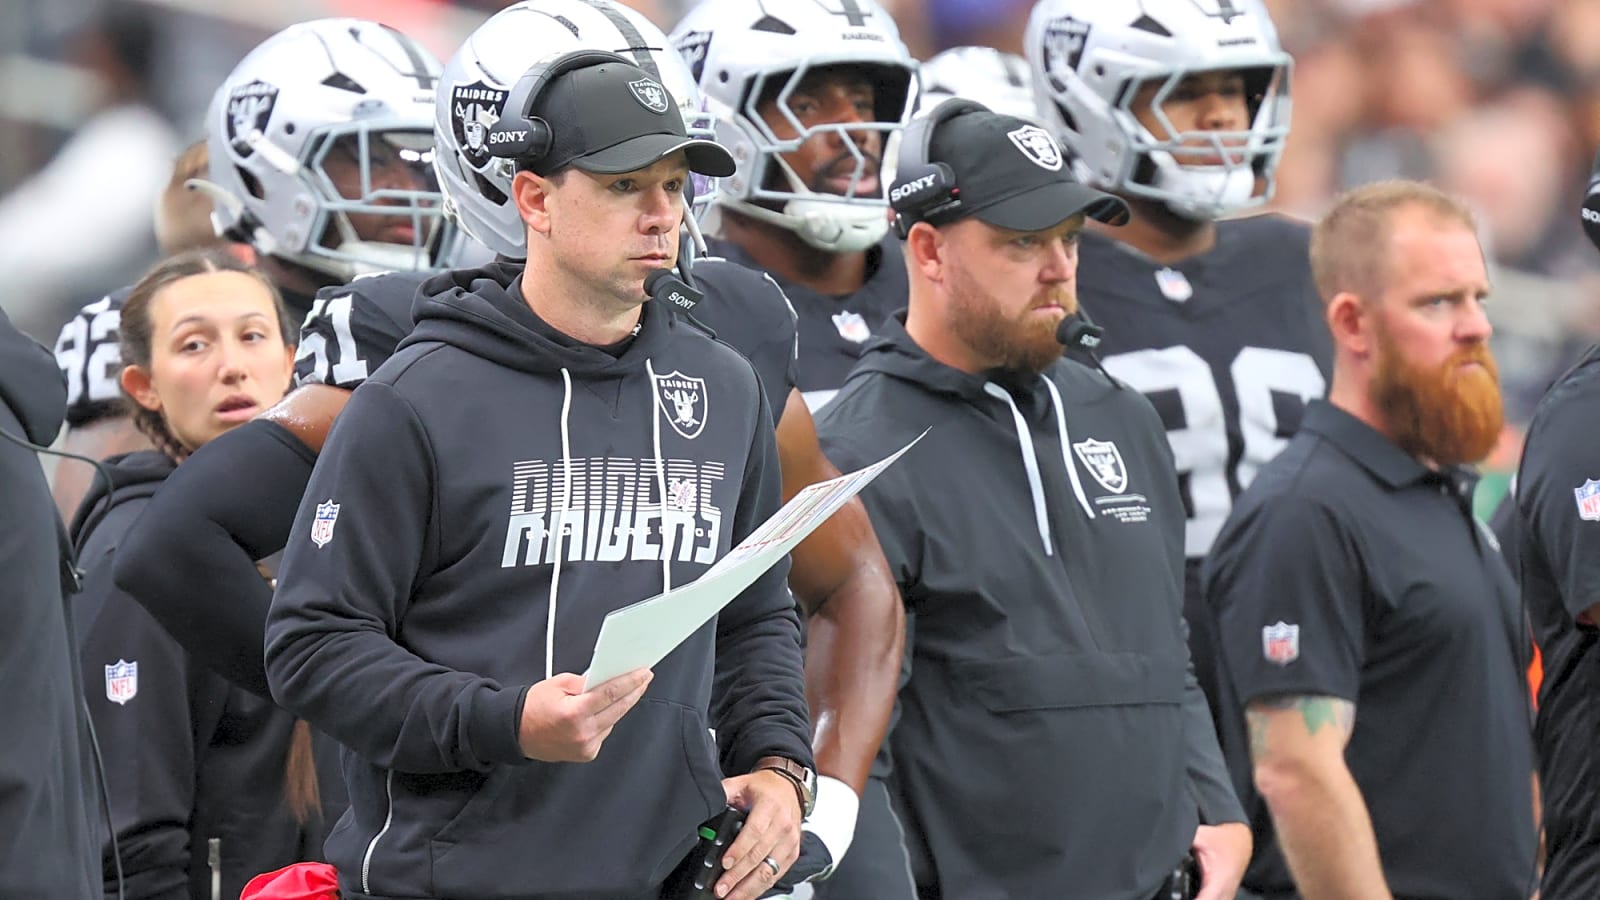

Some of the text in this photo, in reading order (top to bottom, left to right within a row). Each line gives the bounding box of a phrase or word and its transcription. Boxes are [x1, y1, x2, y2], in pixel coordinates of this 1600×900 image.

[455, 87, 504, 102] RAIDERS
[489, 131, 528, 144] SONY
[890, 173, 936, 202] SONY
[1581, 207, 1600, 223] SO
[668, 291, 696, 310] SONY
[293, 293, 368, 387] 51
[54, 308, 122, 405] 92
[501, 457, 725, 569] RAIDERS
[314, 519, 333, 540] NFL
[110, 677, 135, 697] NFL
